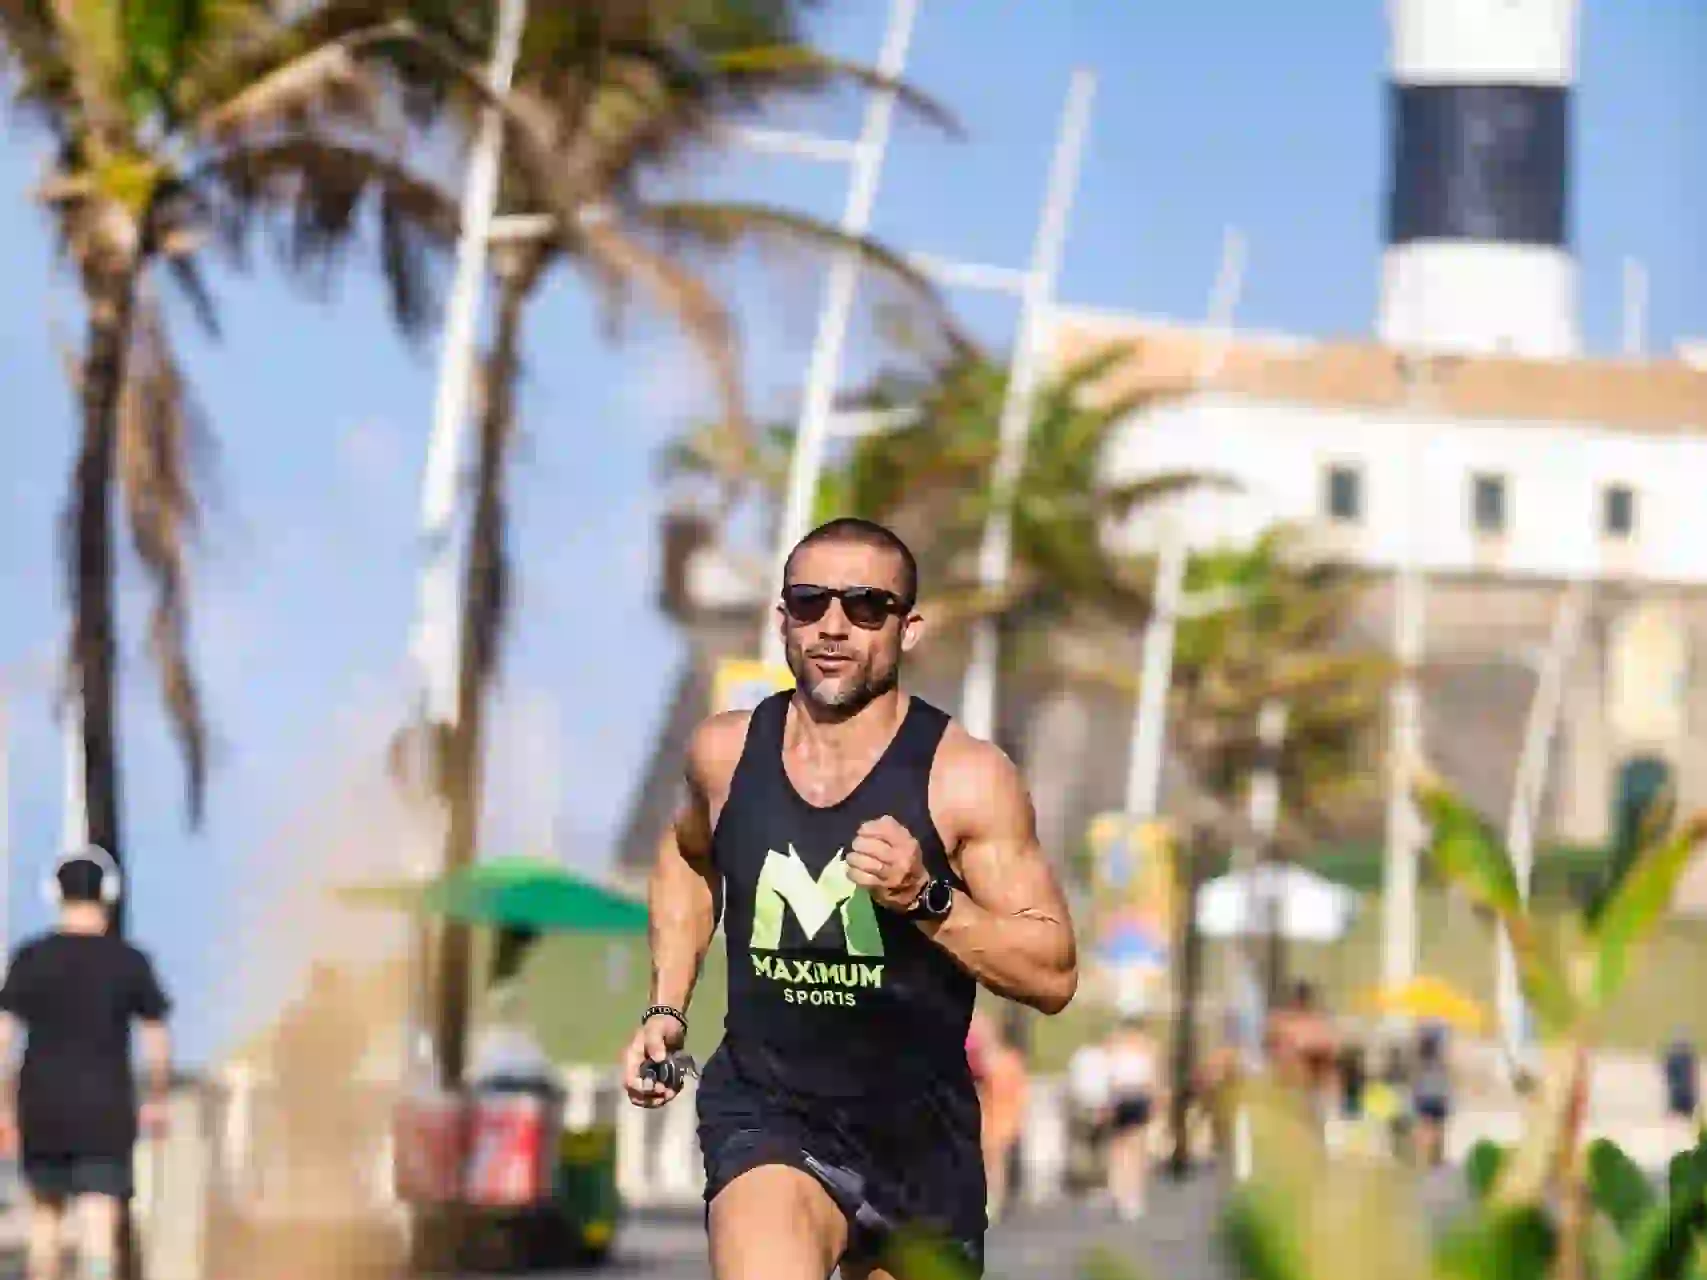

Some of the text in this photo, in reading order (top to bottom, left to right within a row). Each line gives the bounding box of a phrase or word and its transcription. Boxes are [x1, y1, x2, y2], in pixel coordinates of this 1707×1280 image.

[749, 843, 884, 956] M
[751, 954, 884, 988] MAXIMUM
[784, 987, 856, 1007] SPORTS
